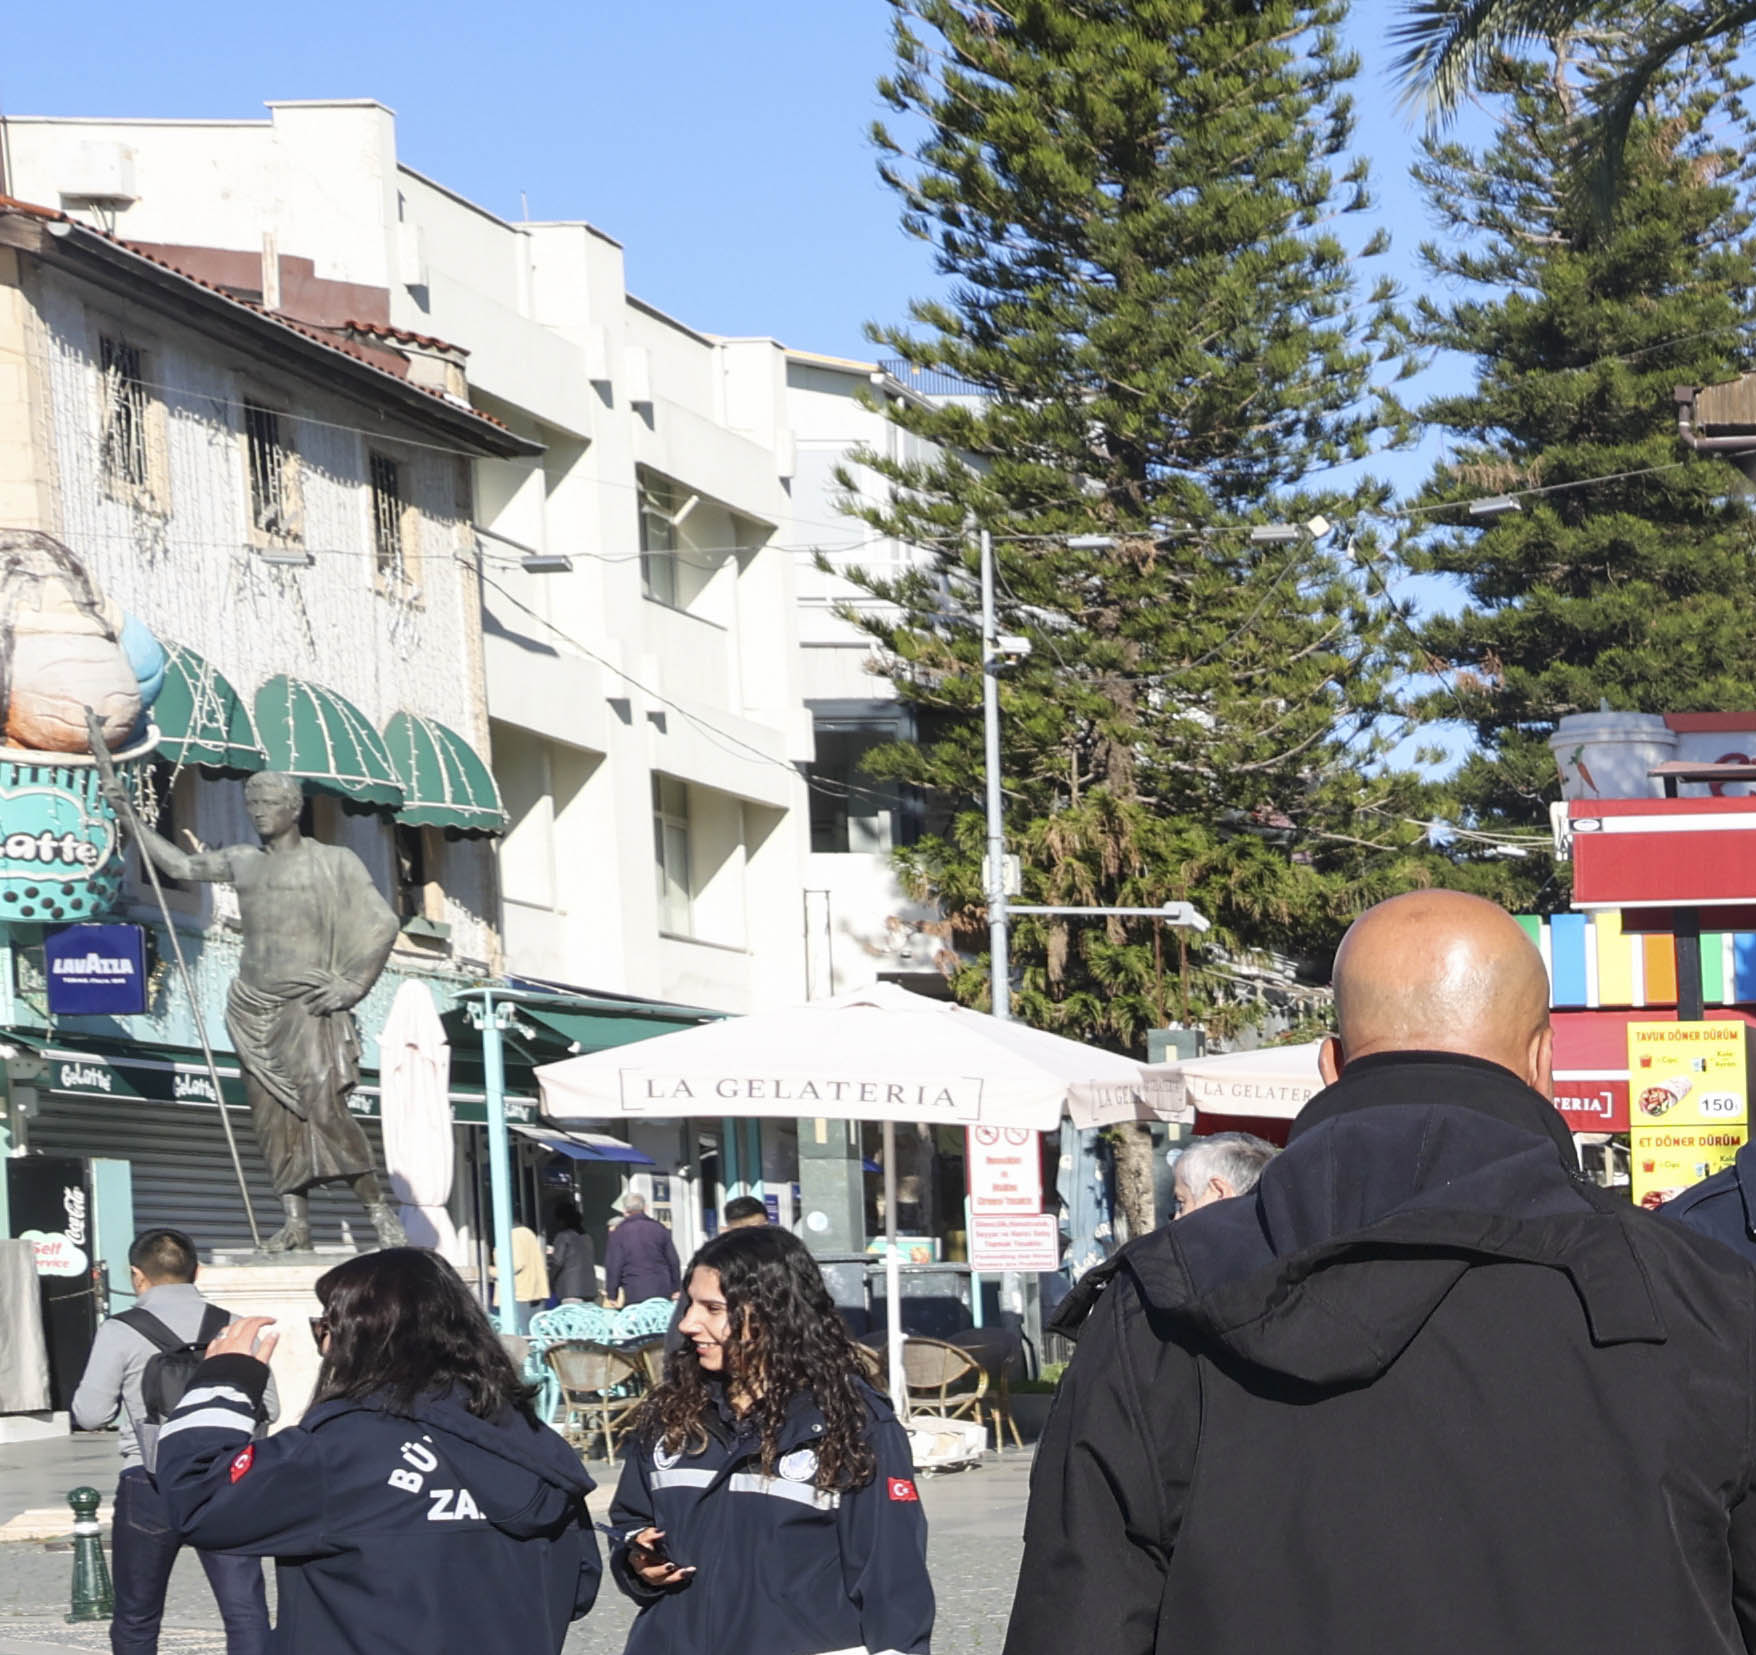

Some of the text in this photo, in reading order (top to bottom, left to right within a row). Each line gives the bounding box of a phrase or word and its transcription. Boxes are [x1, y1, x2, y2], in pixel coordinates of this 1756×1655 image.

[53, 953, 134, 975] LAVAZZA
[1668, 1029, 1700, 1041] DÖNER
[1704, 1029, 1738, 1040] DÜRÜM
[647, 1078, 957, 1109] LA GELATERIA
[1203, 1082, 1224, 1096] LA
[1639, 1136, 1741, 1146] ET DÖNER DÜRÜM
[387, 1434, 438, 1494] BÜ
[427, 1489, 488, 1520] ZA
